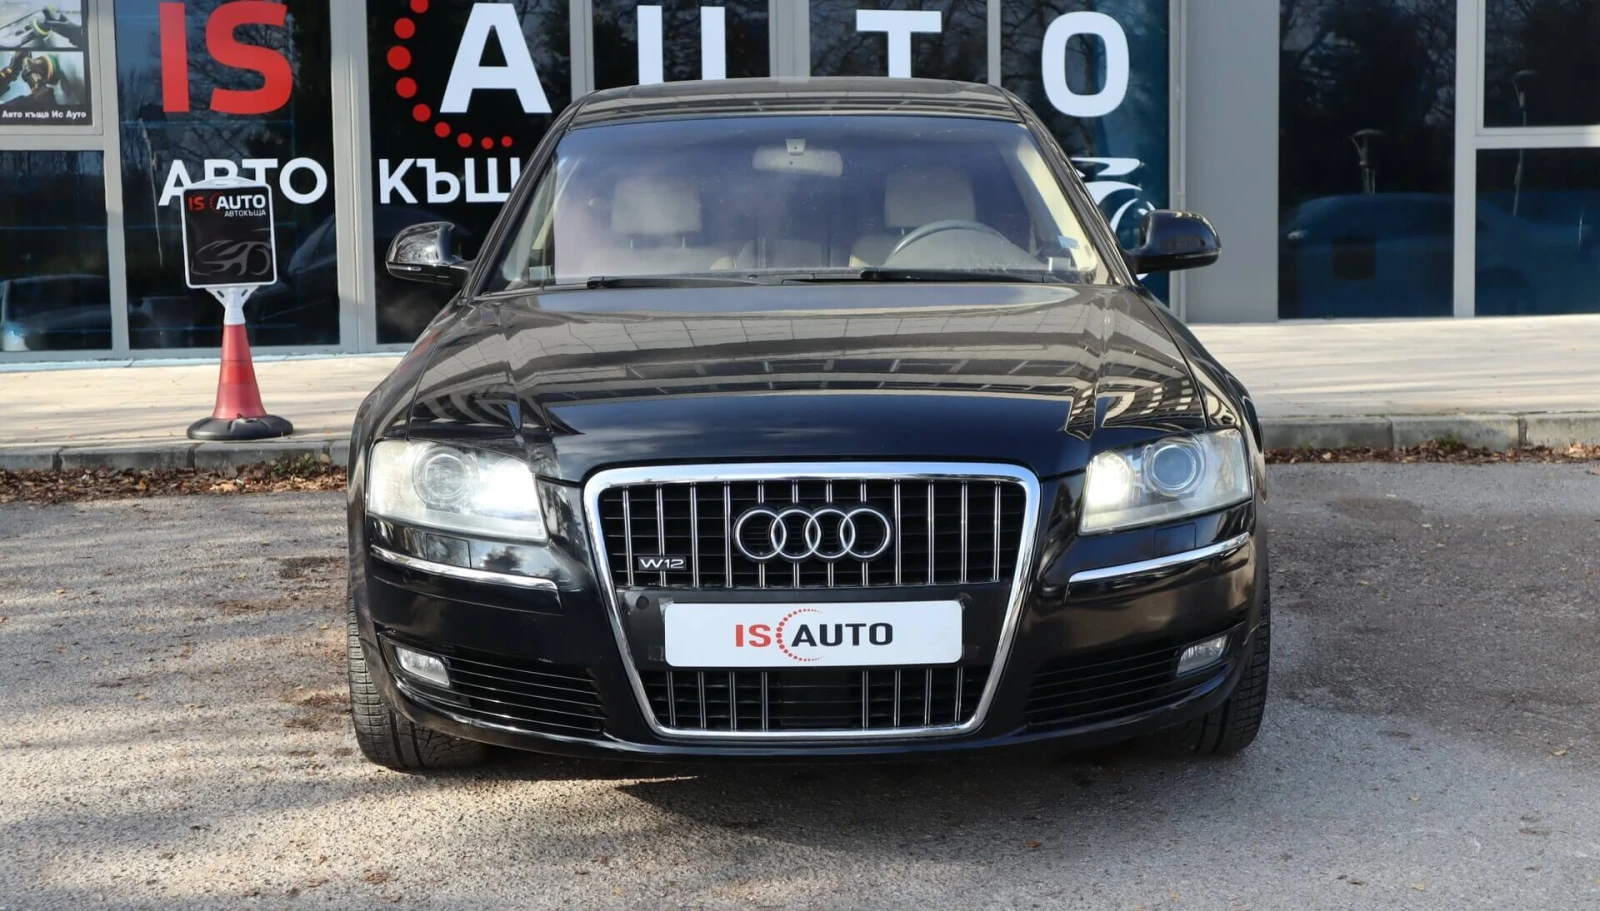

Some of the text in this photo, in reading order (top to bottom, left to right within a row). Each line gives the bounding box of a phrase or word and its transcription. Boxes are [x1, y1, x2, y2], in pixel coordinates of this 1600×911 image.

[160, 1, 293, 114] IS
[2, 110, 86, 119] Авто къща Ис Ауто
[188, 194, 266, 211] IS AUTO
[224, 209, 266, 218] АВТОКЪЩА
[640, 557, 684, 569] W12
[735, 622, 894, 648] IS AUTO
